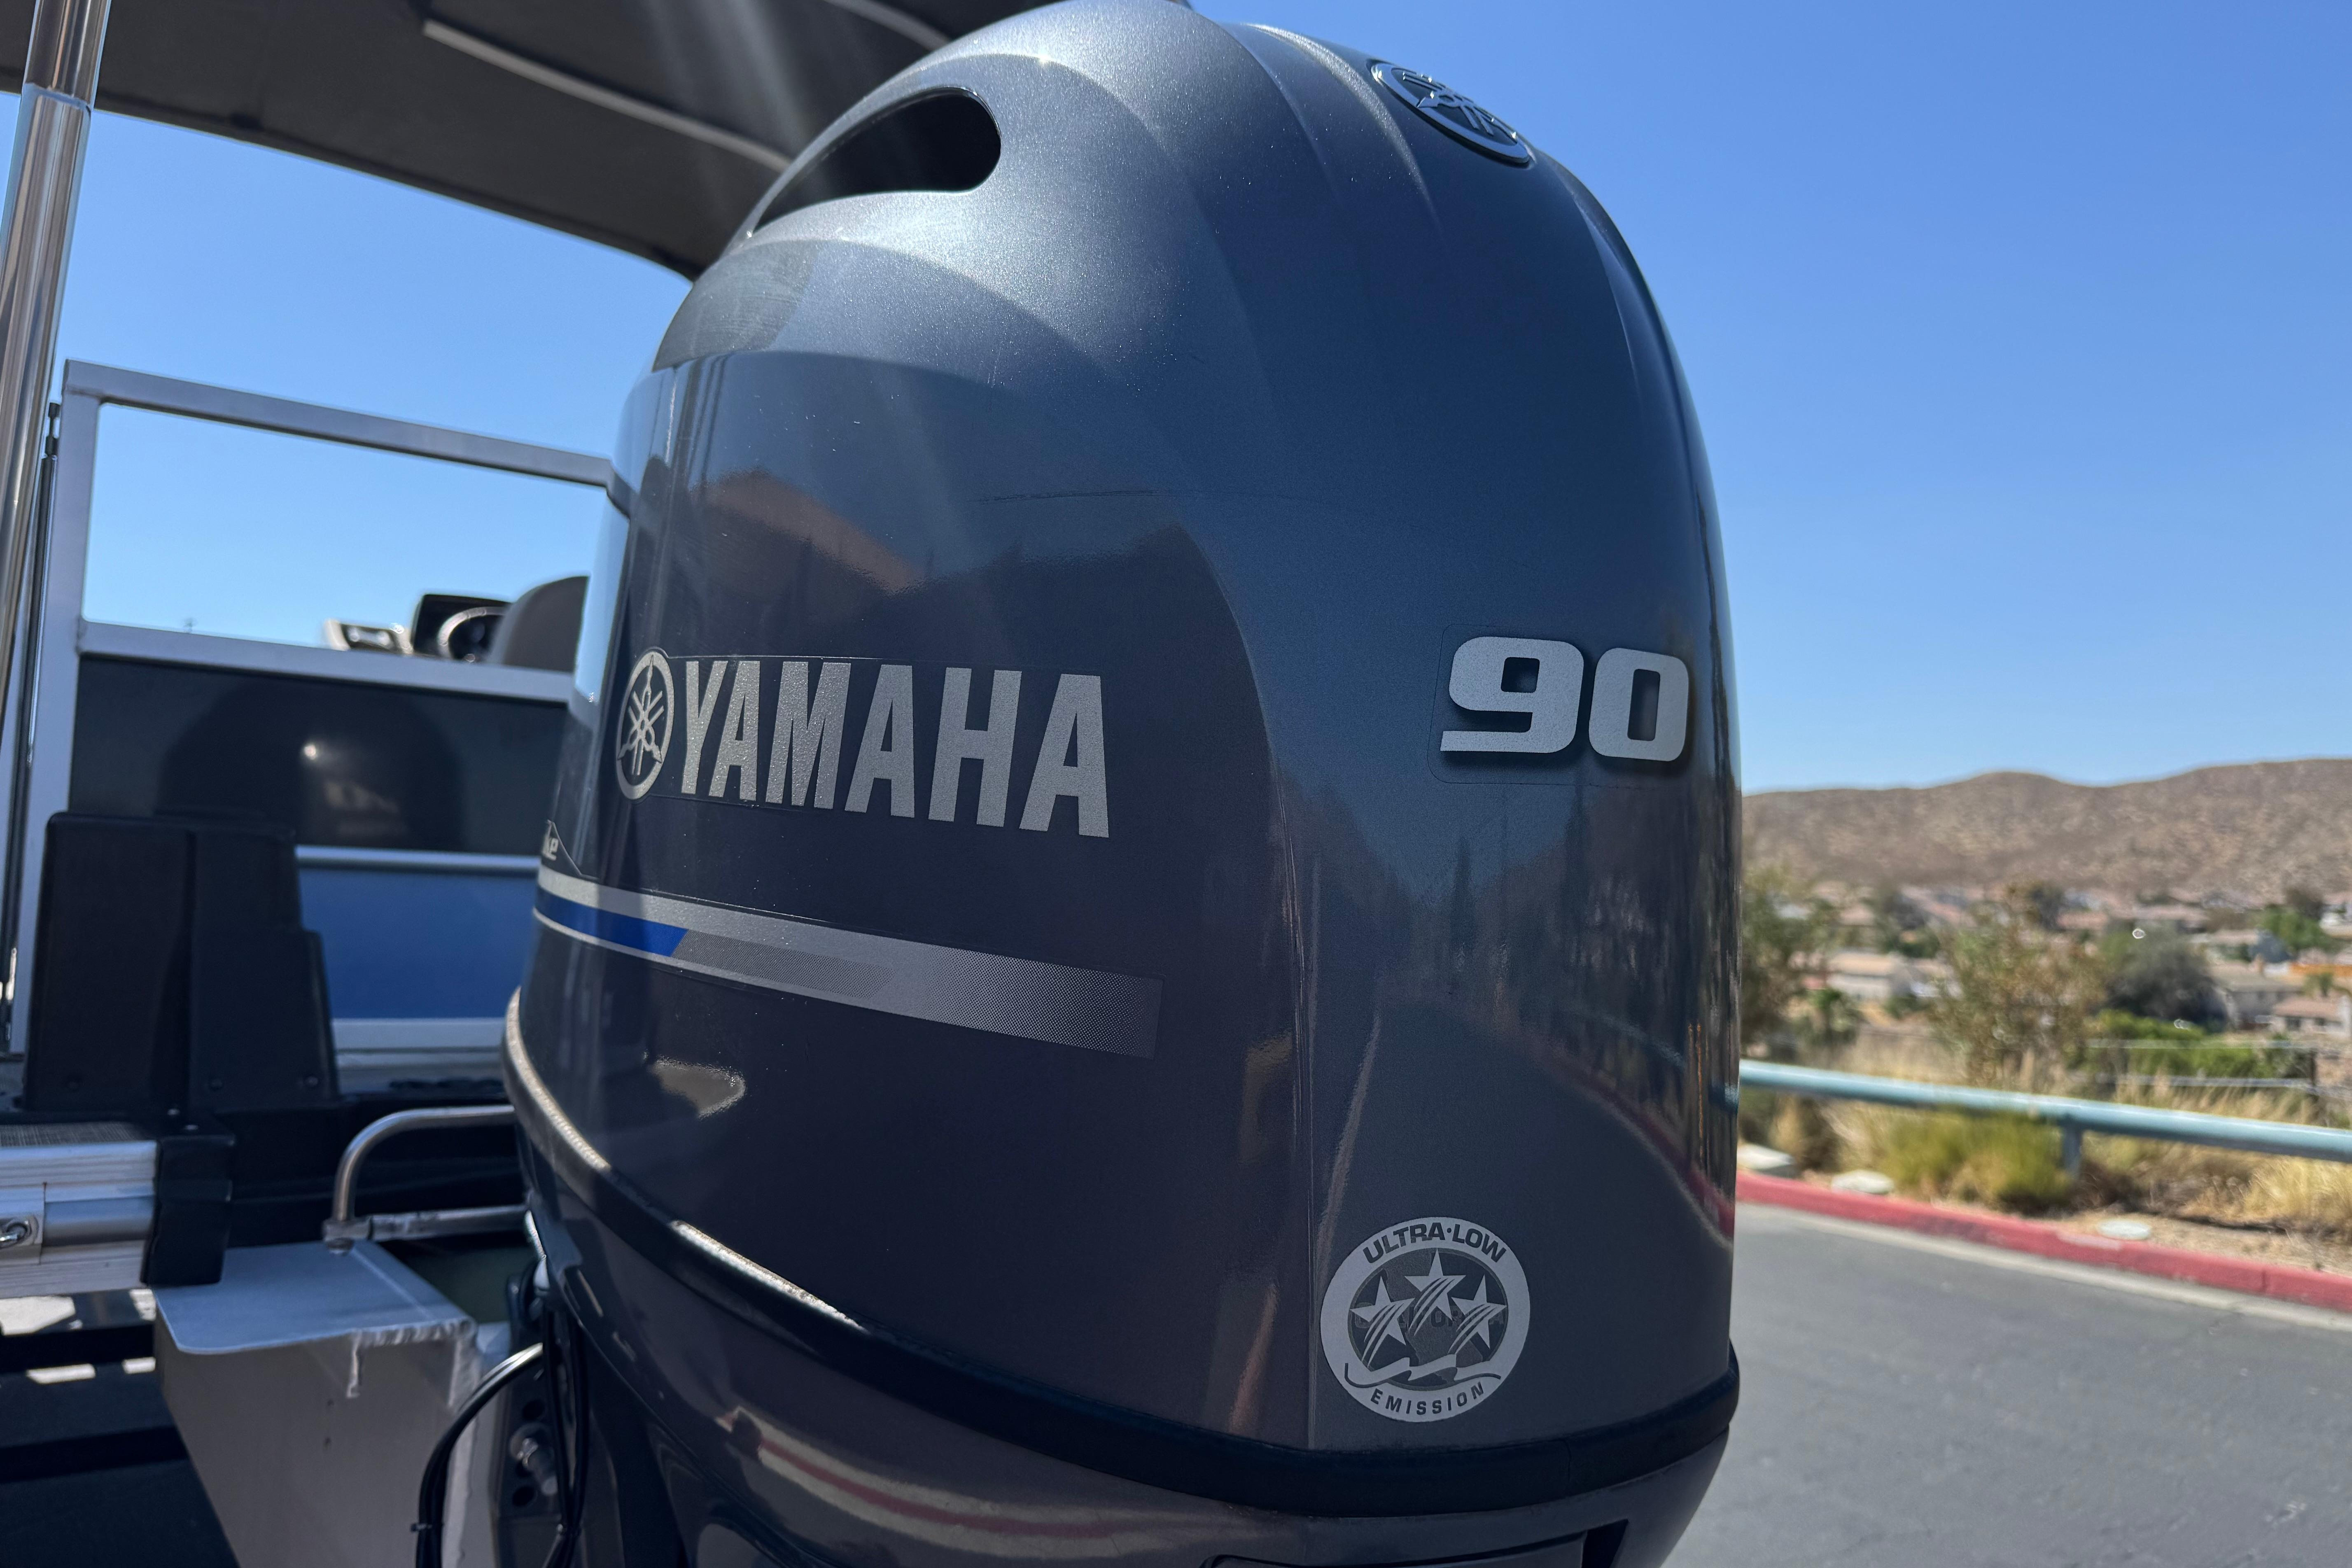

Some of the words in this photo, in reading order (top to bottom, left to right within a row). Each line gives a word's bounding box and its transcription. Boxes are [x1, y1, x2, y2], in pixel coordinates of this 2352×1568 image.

[681, 660, 1109, 838] YAMAHA
[1440, 636, 1689, 762] 90
[1370, 1381, 1484, 1415] EMISSION
